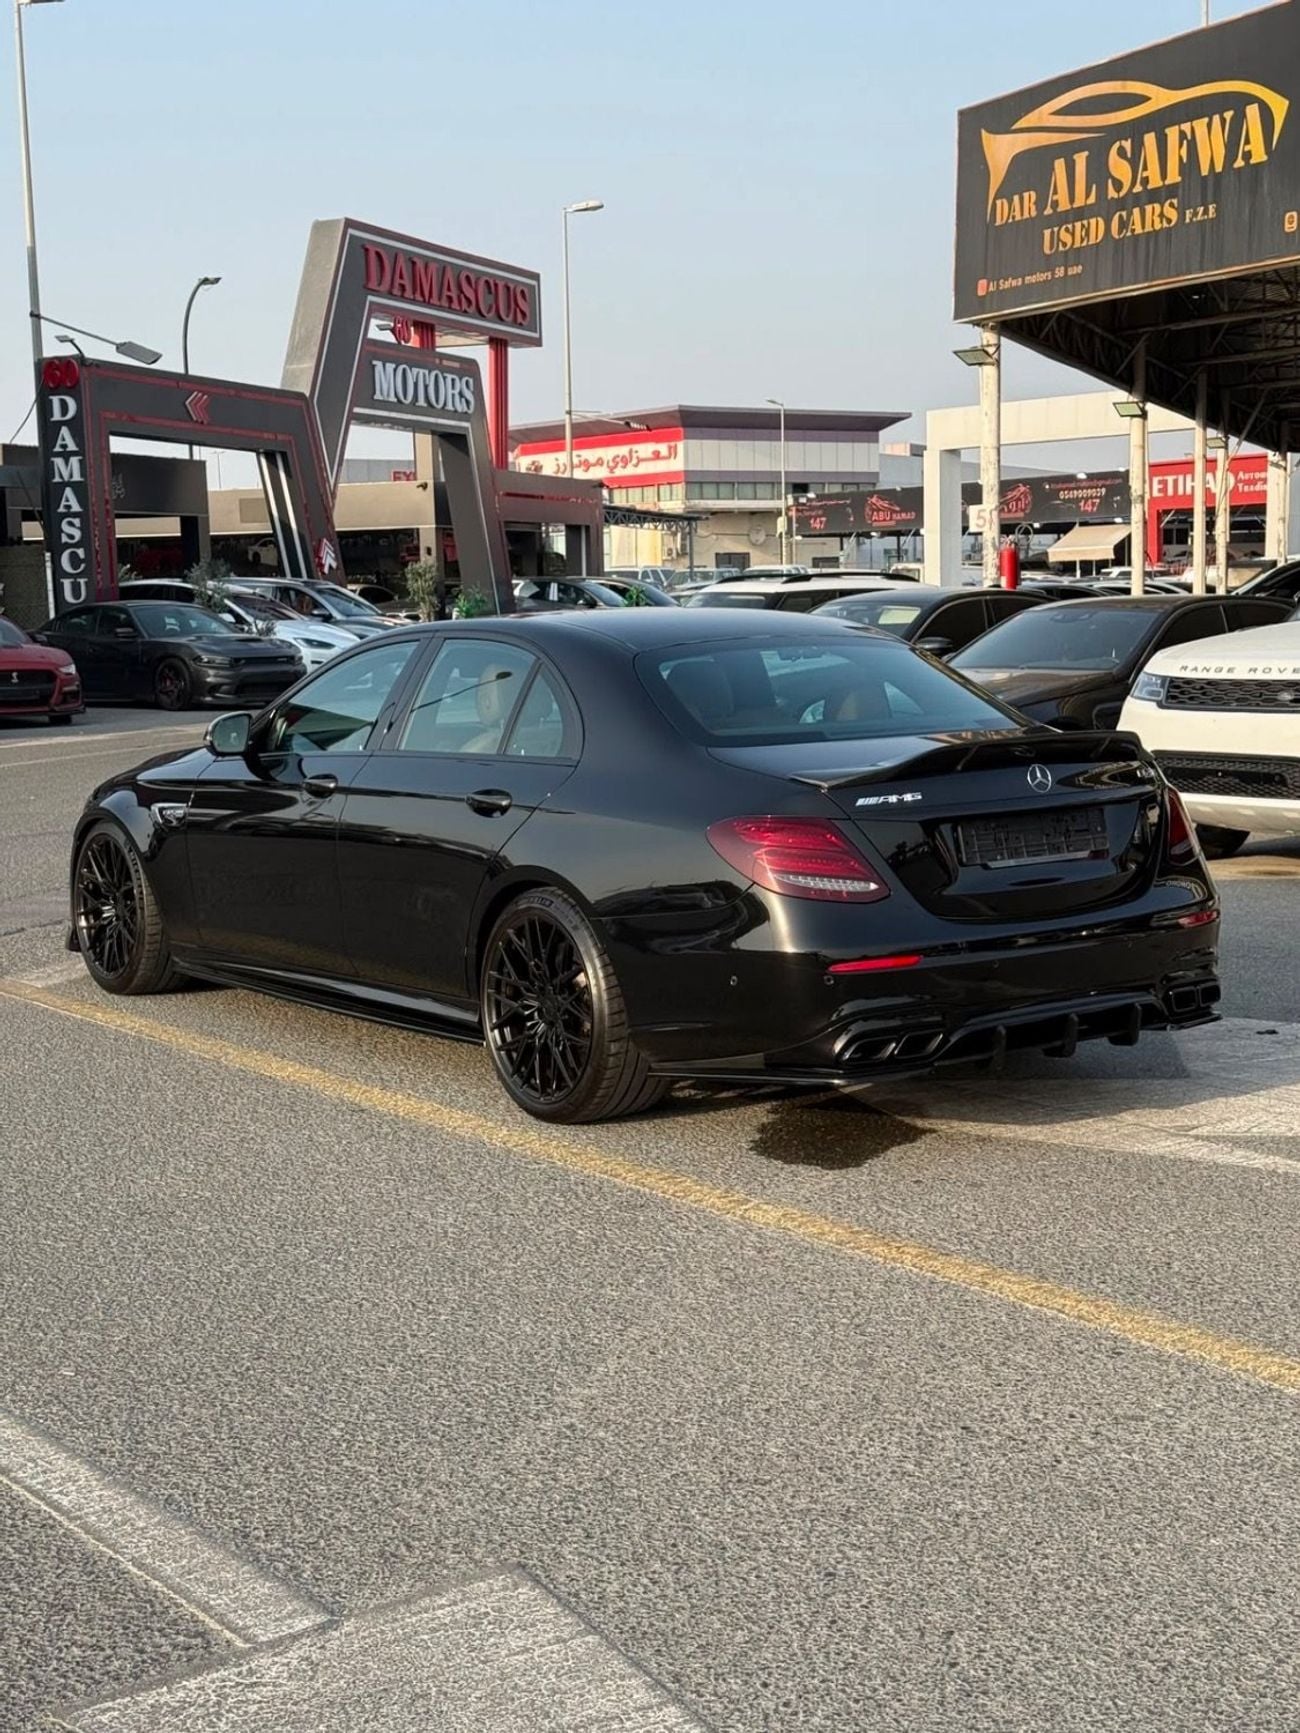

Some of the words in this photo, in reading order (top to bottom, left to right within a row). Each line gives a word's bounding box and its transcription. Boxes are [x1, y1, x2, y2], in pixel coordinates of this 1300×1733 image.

[995, 190, 1037, 226] DAR
[1043, 151, 1096, 215] AL
[1107, 103, 1268, 200] SAFWA
[1043, 216, 1105, 255] USED
[1110, 198, 1178, 239] CARS
[1184, 204, 1217, 223] F.Z.E
[362, 244, 530, 326] DAMASCUS
[988, 280, 997, 292] Al
[999, 277, 1022, 290] Safwa
[1024, 271, 1052, 285] motors
[43, 359, 80, 389] 60
[371, 360, 475, 414] MOTORS
[553, 454, 604, 475] موترز
[607, 443, 678, 474] العزاوي
[872, 511, 891, 521] ABU
[1079, 499, 1100, 512] 147
[1179, 665, 1236, 674] RANGE
[877, 791, 923, 804] AMG
